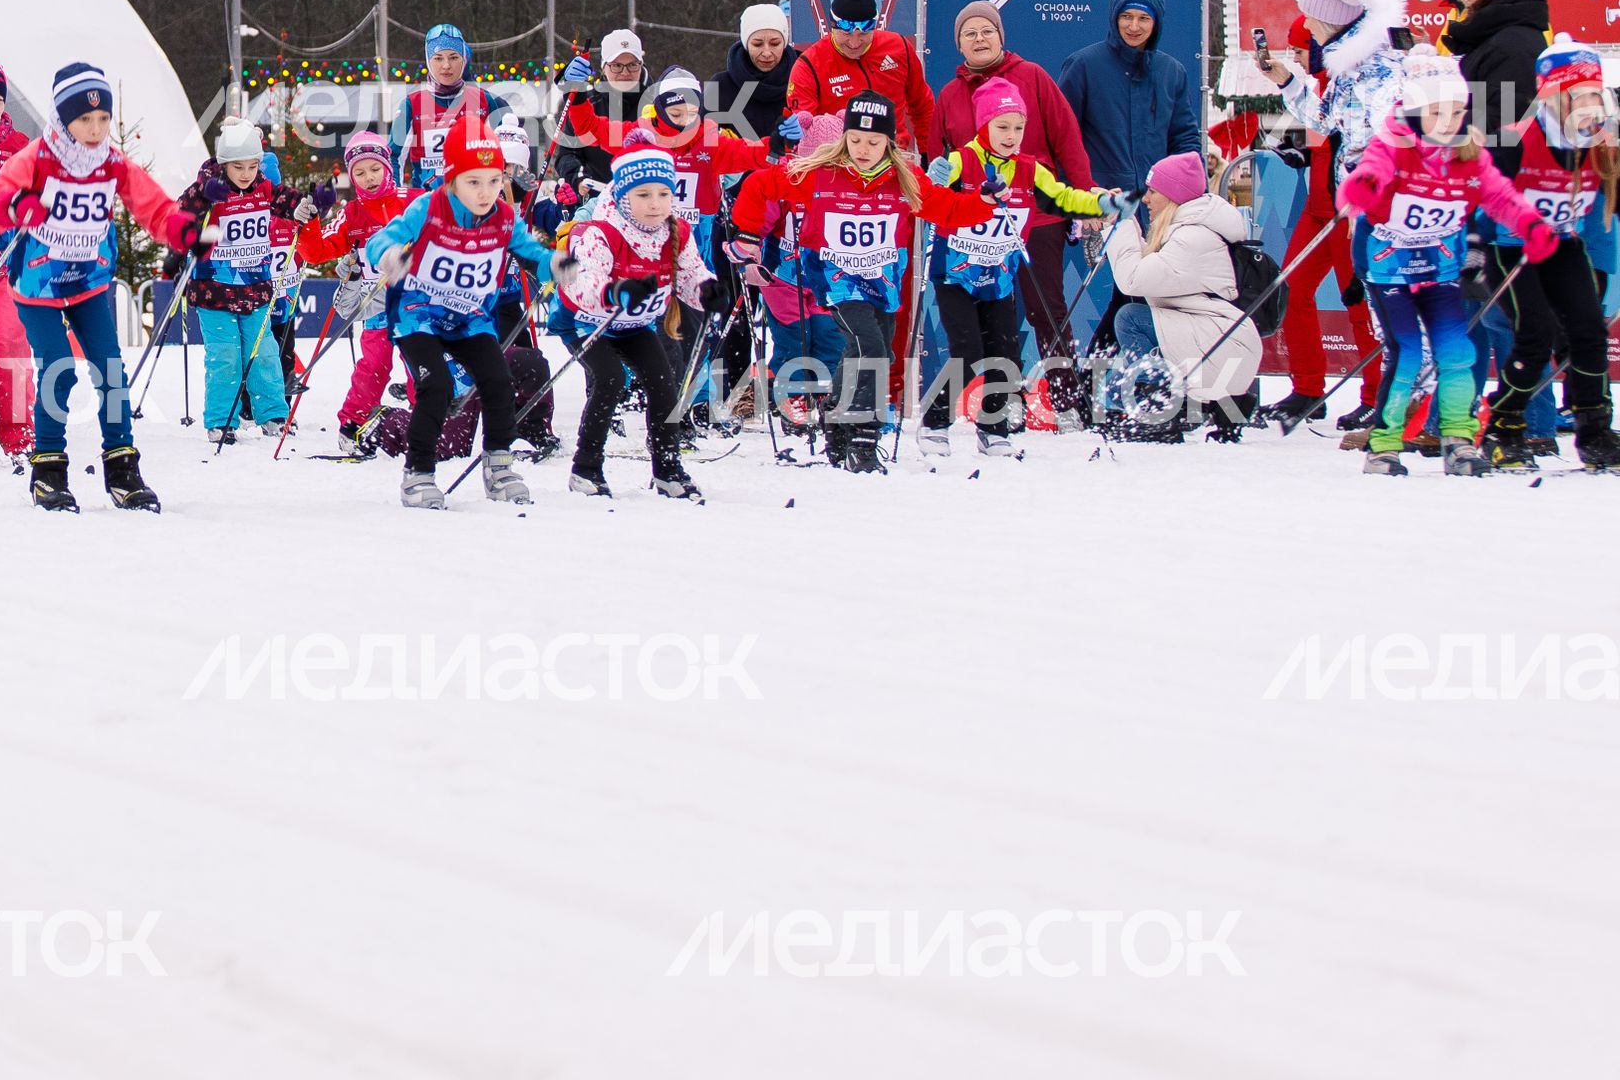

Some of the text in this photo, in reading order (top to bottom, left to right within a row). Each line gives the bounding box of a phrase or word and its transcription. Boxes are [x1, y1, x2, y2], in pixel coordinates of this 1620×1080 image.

[1034, 3, 1091, 12] ОСНОВАНА
[1050, 13, 1073, 22] 1969
[851, 101, 887, 116] SATURN
[50, 190, 109, 223] 653
[1404, 203, 1456, 230] 631
[226, 215, 268, 242] 666
[839, 220, 887, 247] 661
[821, 249, 898, 268] МАНЖОСОВСКАЯ
[430, 256, 492, 289] 663
